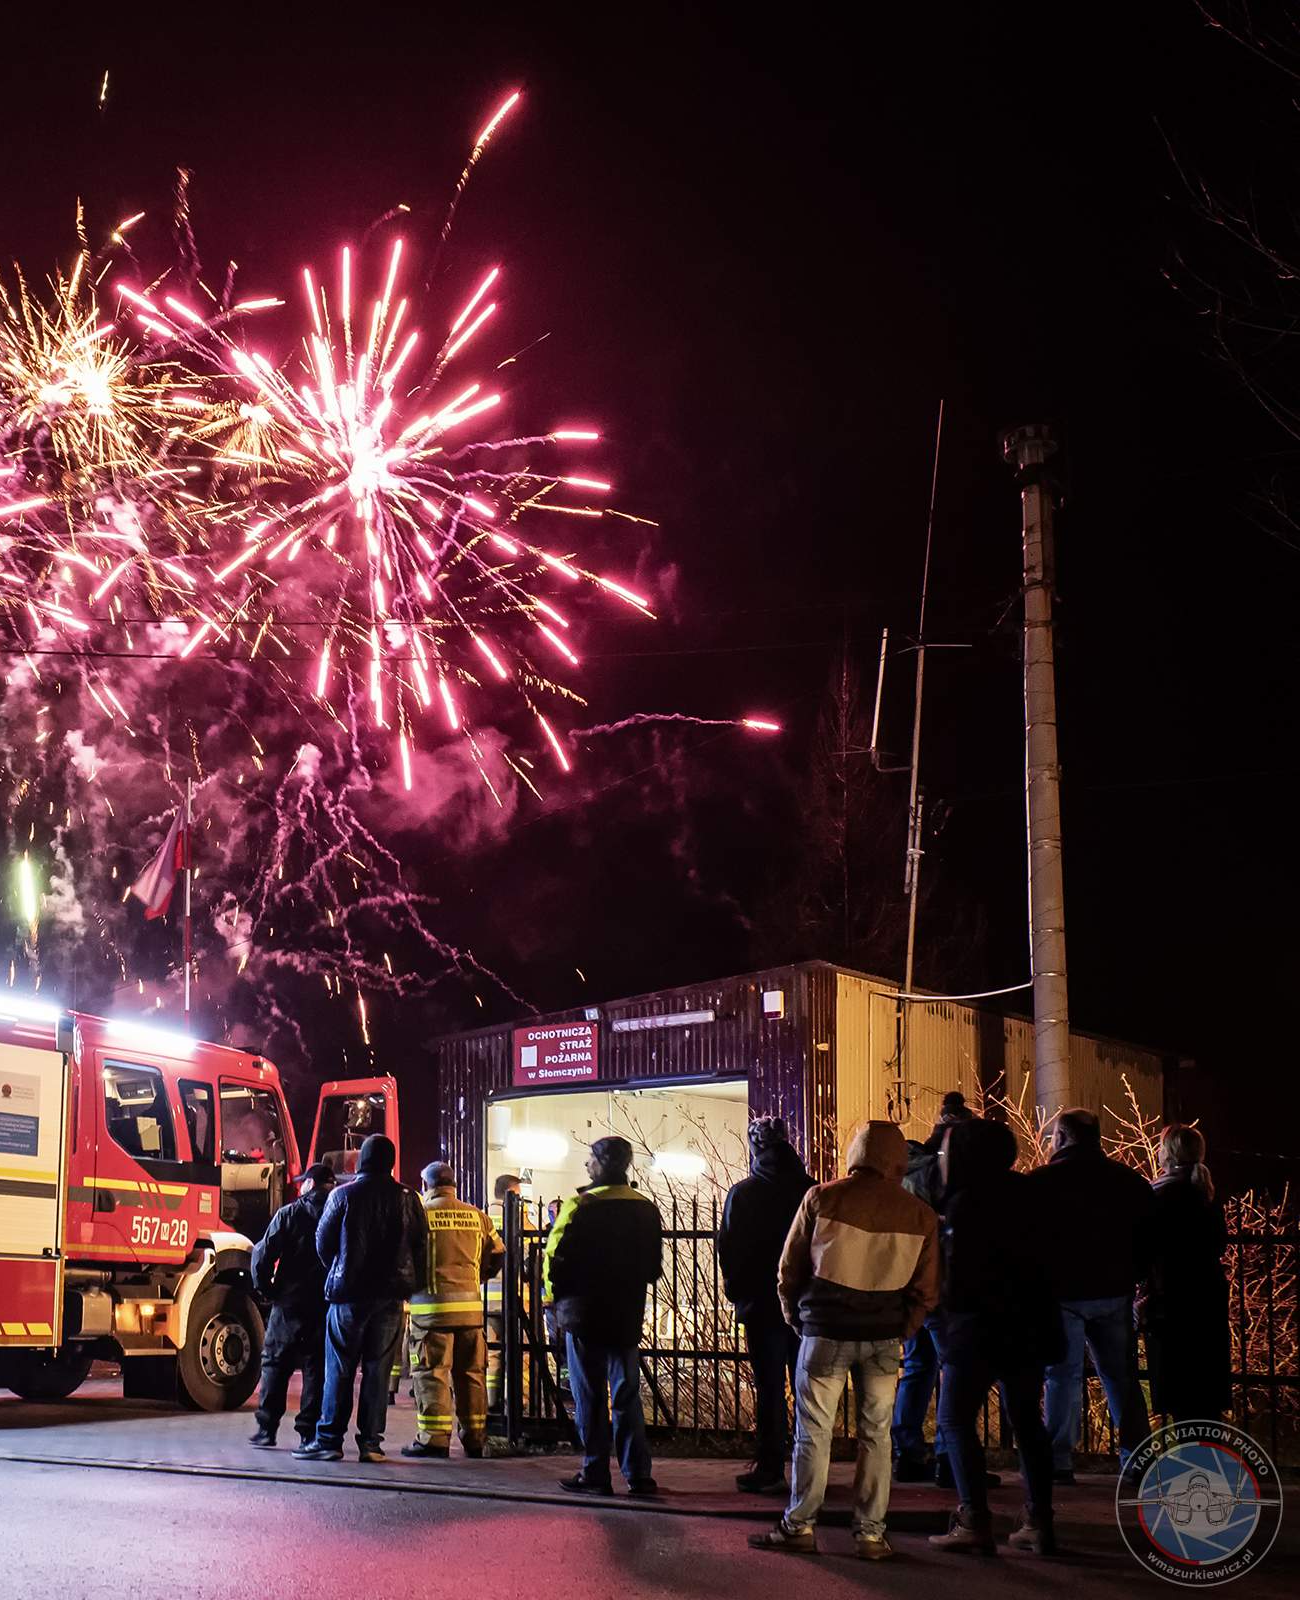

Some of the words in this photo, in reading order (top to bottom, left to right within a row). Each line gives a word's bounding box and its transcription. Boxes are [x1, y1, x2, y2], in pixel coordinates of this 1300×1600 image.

[528, 1026, 592, 1041] OCHOTNICZA
[559, 1037, 592, 1051] STRAŻ
[545, 1052, 592, 1064] POŻARNA
[538, 1065, 593, 1079] Słomczynie
